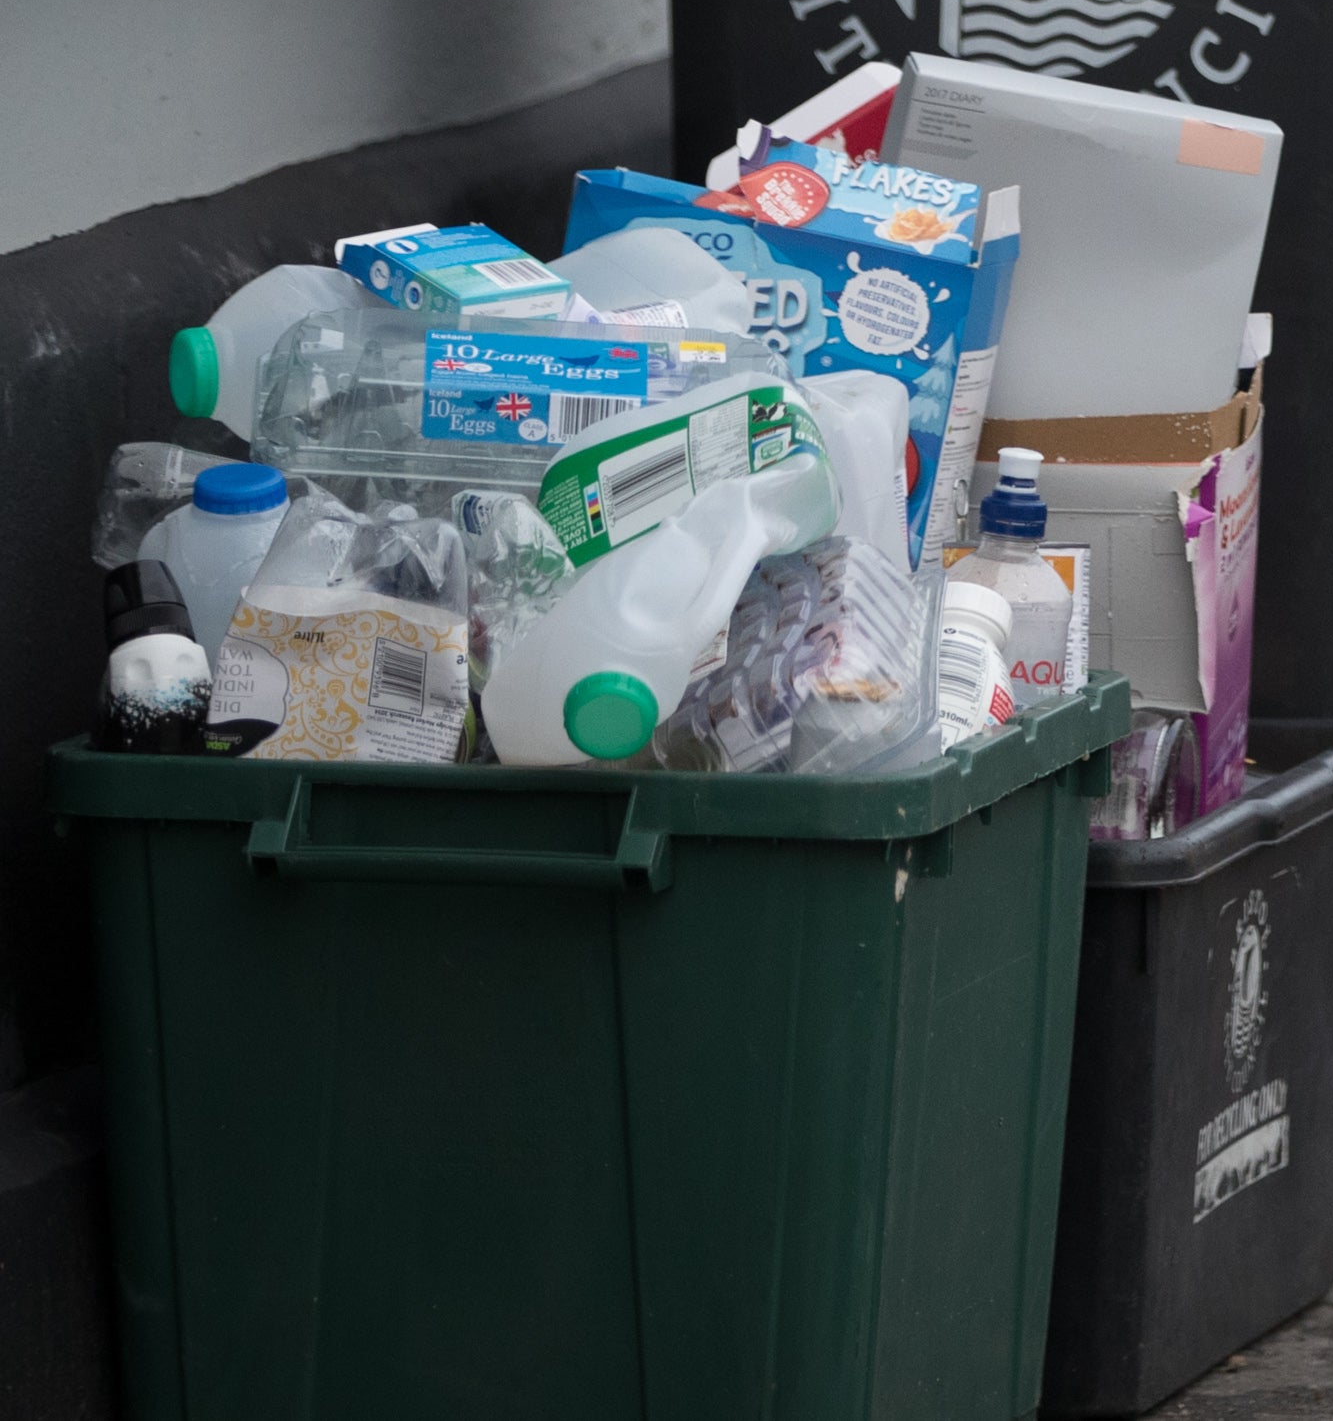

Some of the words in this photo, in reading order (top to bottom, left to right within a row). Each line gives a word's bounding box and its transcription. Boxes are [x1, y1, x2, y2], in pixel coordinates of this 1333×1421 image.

[924, 86, 948, 99] 2017
[949, 91, 984, 105] DIARY
[831, 155, 955, 206] FLAKES
[868, 278, 879, 287] NO
[442, 343, 479, 359] 10
[482, 349, 555, 366] Large
[541, 362, 620, 380] Eggs
[428, 388, 463, 399] Iceland
[428, 399, 449, 418] 10
[450, 414, 496, 436] Eggs
